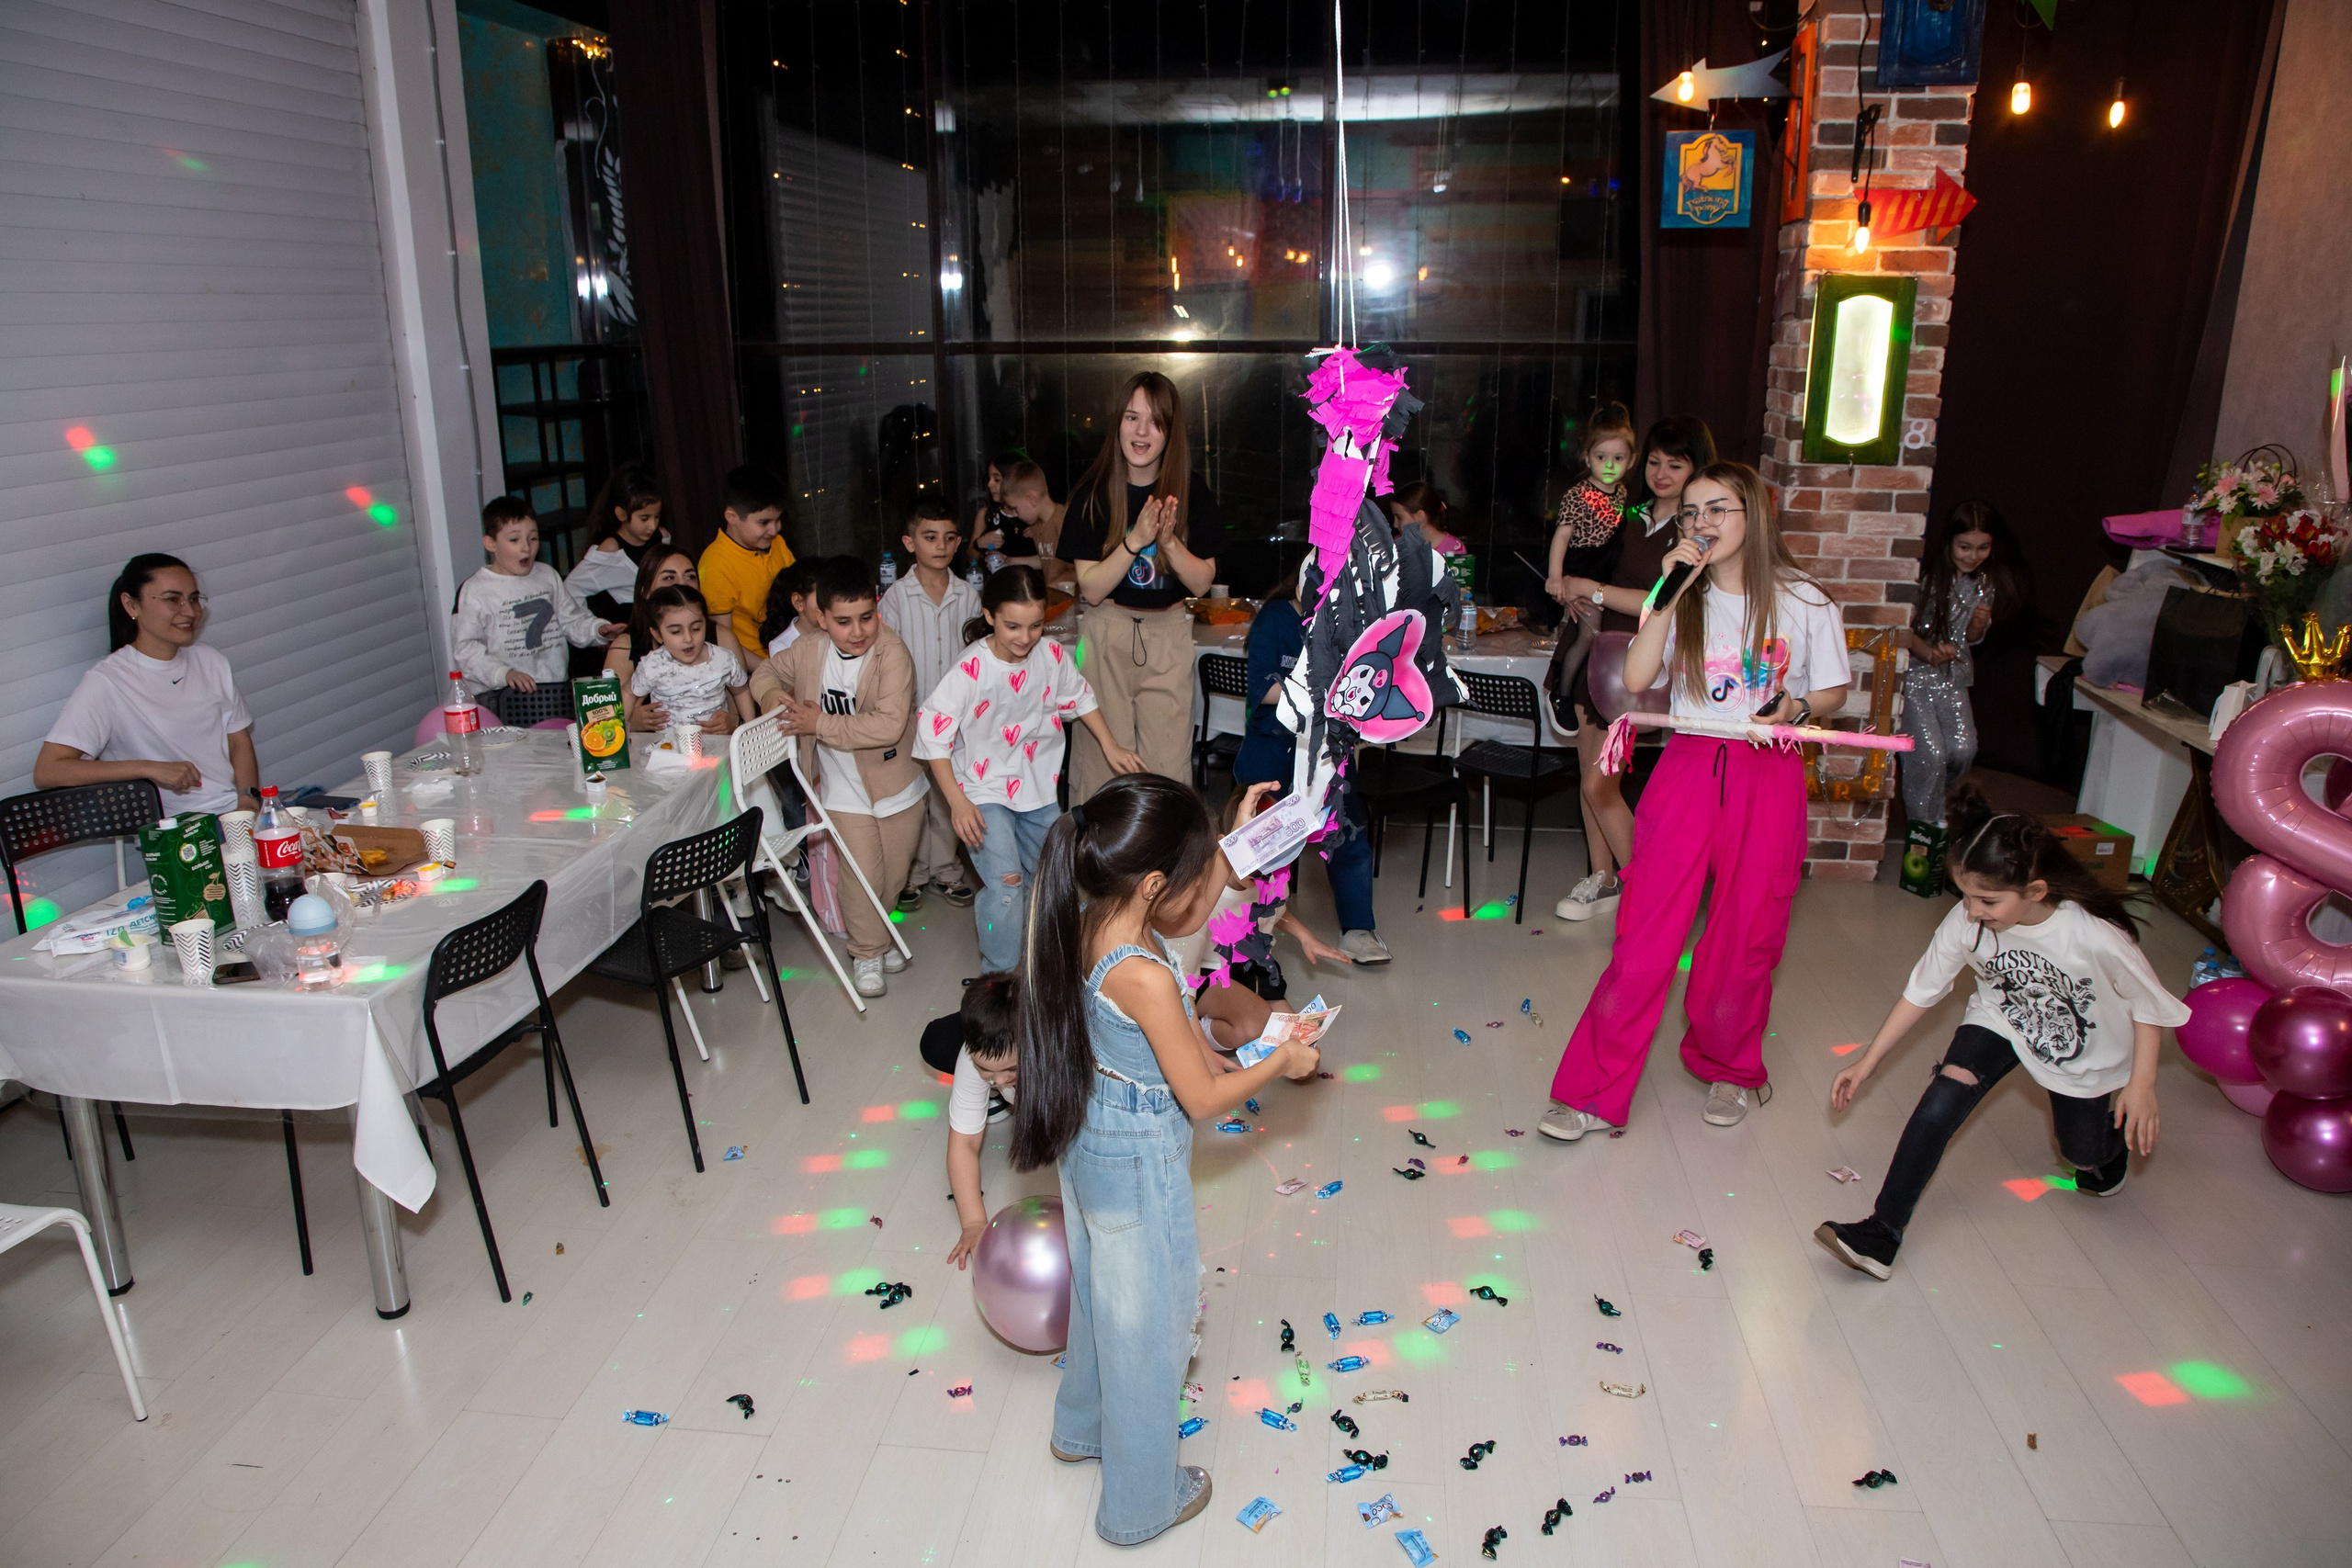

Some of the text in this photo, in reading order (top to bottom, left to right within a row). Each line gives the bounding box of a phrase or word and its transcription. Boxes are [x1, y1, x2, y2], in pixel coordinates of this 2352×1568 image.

[1904, 419, 1928, 449] 8
[512, 598, 554, 650] 7
[582, 691, 616, 706] Добрый
[1286, 795, 1300, 807] 500
[1283, 818, 1306, 837] 500
[1224, 834, 1238, 847] 500
